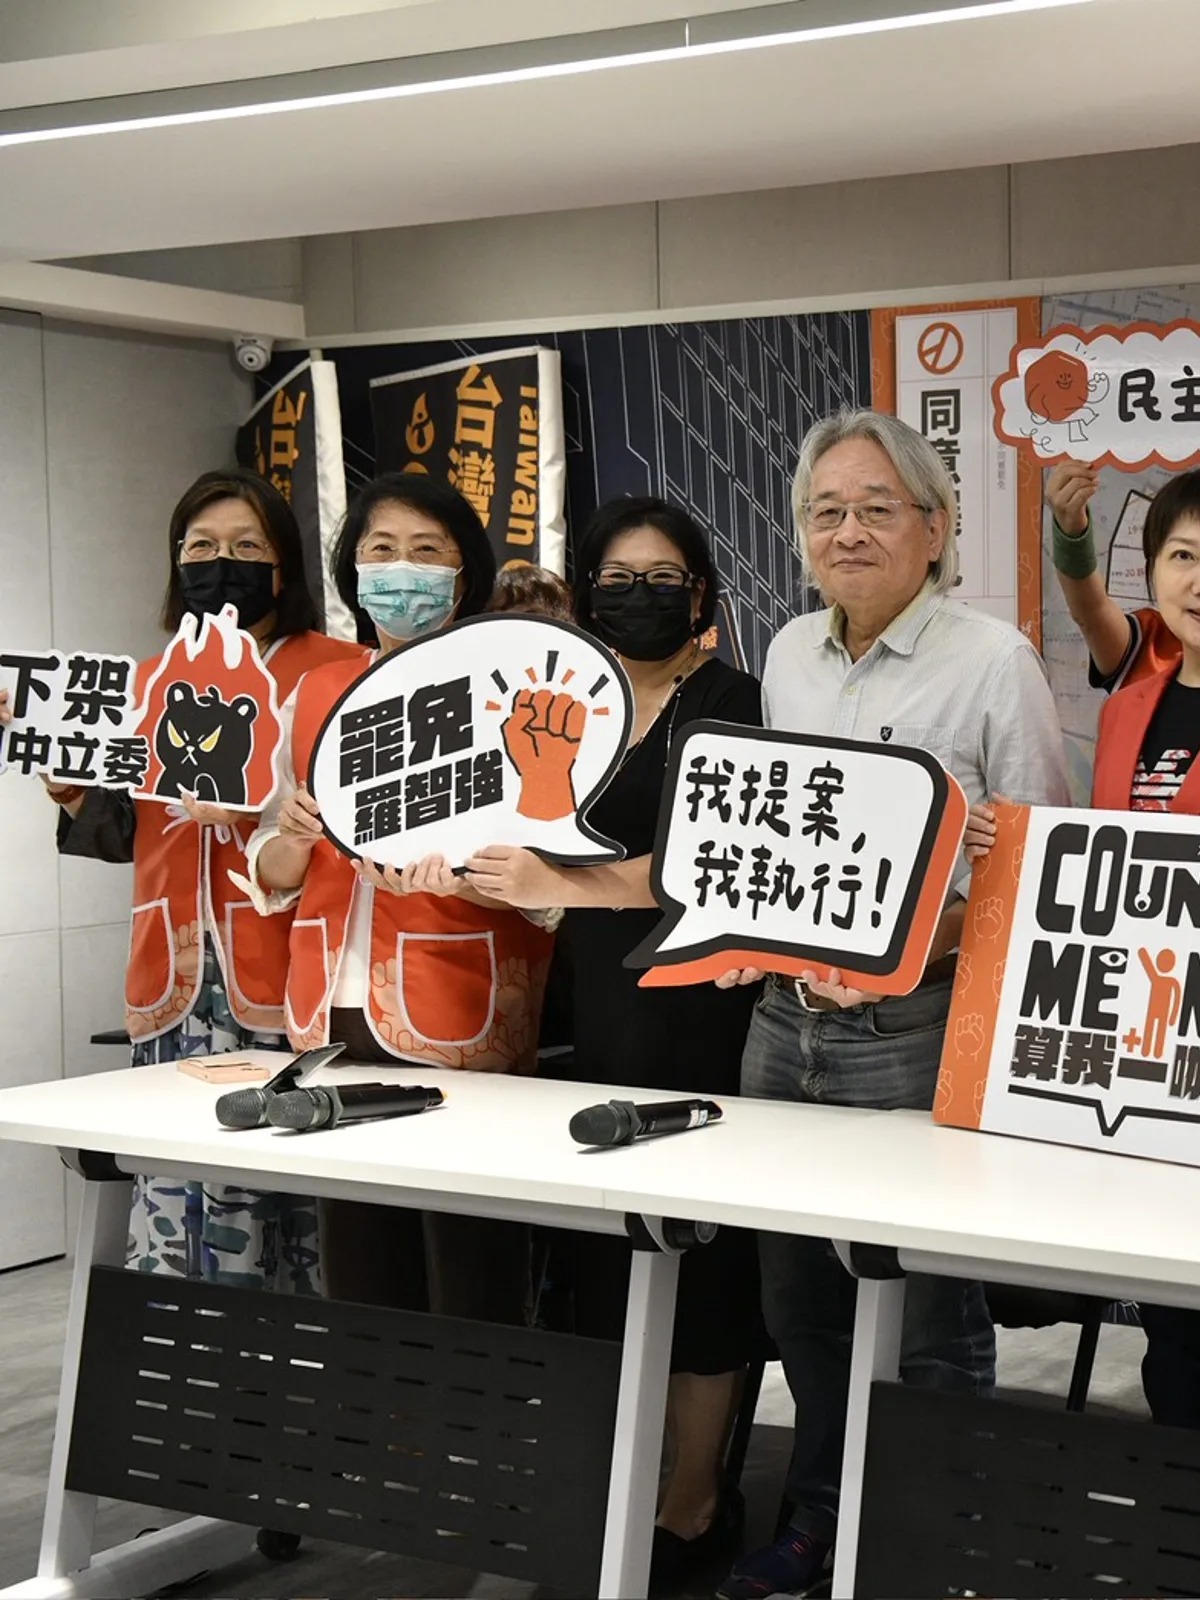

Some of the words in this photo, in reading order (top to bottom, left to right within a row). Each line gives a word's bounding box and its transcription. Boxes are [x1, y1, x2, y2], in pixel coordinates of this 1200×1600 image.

[0, 654, 130, 726] 下架
[340, 675, 474, 788] 罷免
[0, 724, 148, 786] 中立委
[354, 748, 503, 846] 羅智強
[685, 756, 866, 853] 我提案,
[694, 840, 892, 930] 我執行!
[1019, 940, 1129, 1031] ME
